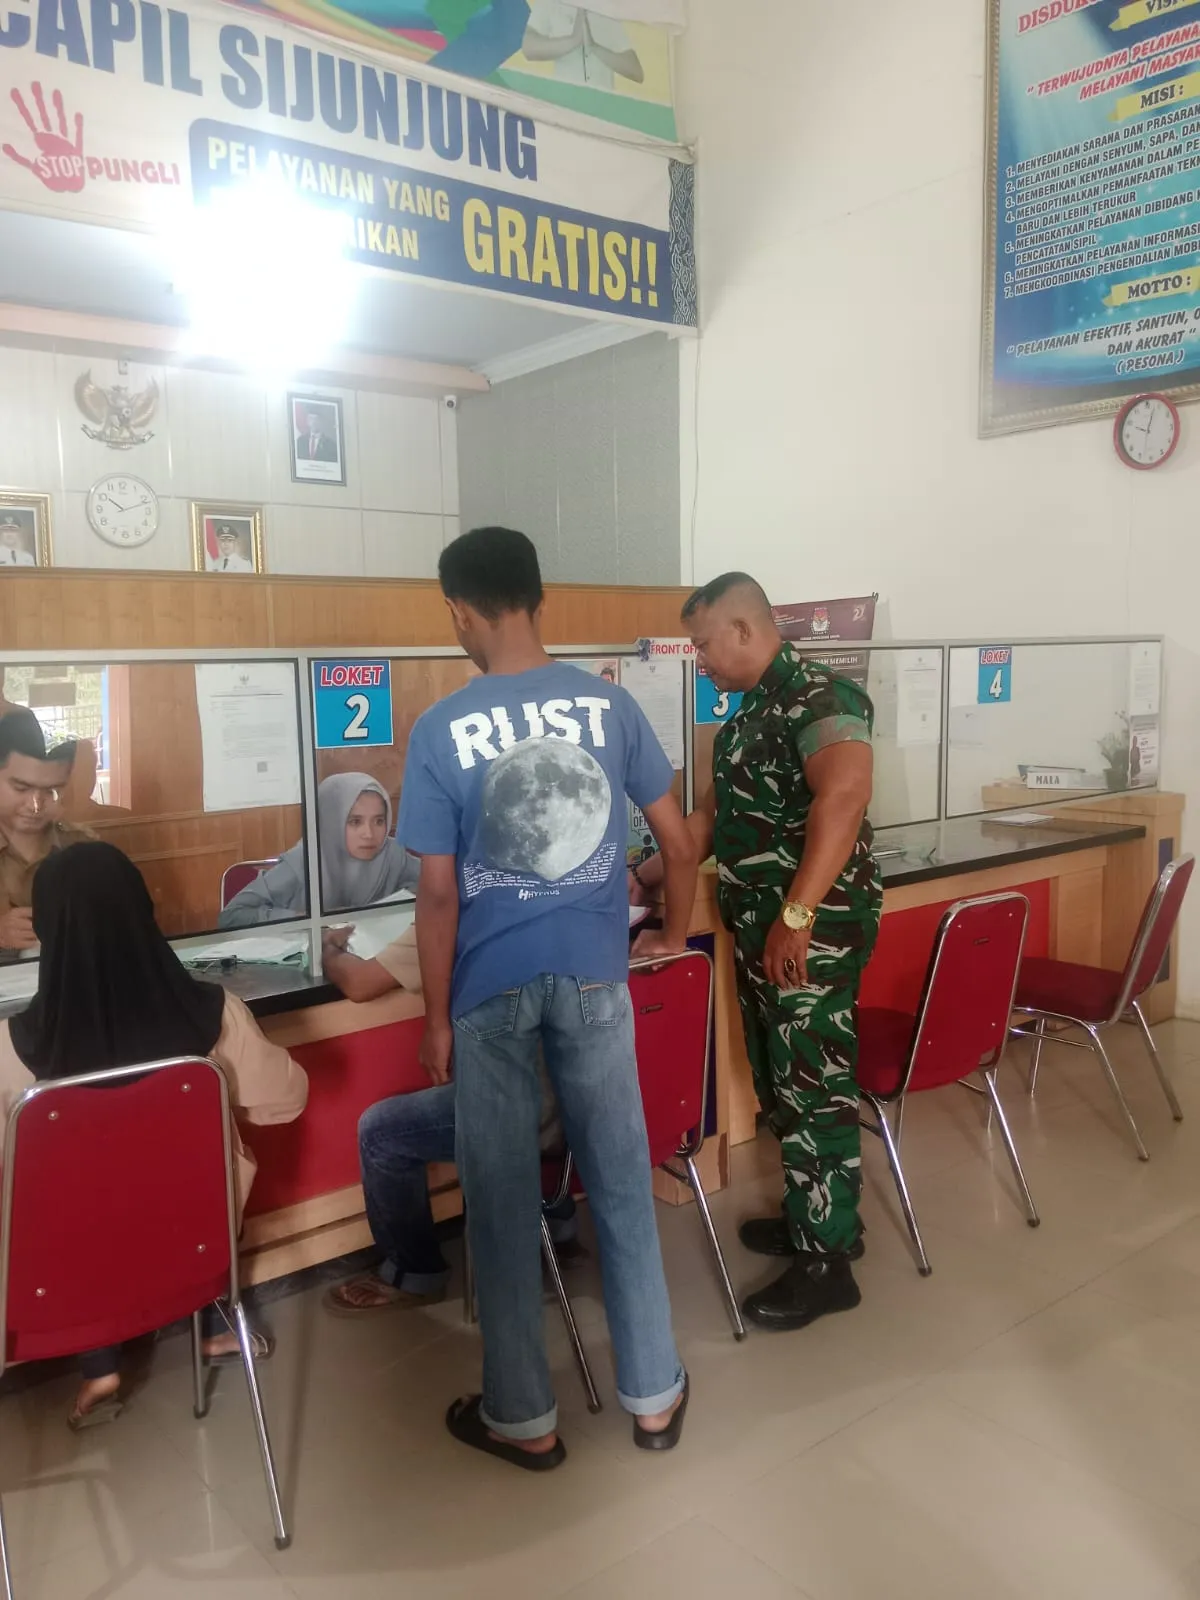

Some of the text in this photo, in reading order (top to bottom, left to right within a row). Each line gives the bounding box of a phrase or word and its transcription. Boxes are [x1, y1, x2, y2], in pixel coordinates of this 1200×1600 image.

[1018, 0, 1097, 33] DISDU
[1037, 51, 1129, 96] TERWUJUDNYA
[1131, 22, 1200, 61] PELAYANA
[218, 23, 538, 183] SIJUNJUNG
[1079, 63, 1146, 101] MELAYANI
[1140, 84, 1176, 109] MISI
[38, 154, 181, 186] STOP PUNGLI
[1017, 144, 1081, 174] MENYEDIAKAN
[1083, 133, 1121, 153] SARANA
[1123, 123, 1144, 139] DAN
[1017, 167, 1060, 190] MELAYANI
[1062, 154, 1100, 174] DENGAN
[1102, 139, 1146, 163] SENYUM,
[1149, 129, 1179, 147] SAPA,
[207, 136, 451, 223] PELAYANAN YANG
[1016, 186, 1100, 220] MENGOPTIMALKAN
[1102, 163, 1174, 193] PEMANFAATAN
[1017, 176, 1077, 205] MEMBERIKAN
[1079, 156, 1144, 186] KENYAMANAN
[1147, 143, 1183, 165] DALAM
[1016, 191, 1137, 235] BARU DAN LEBIH TERUKUR
[1016, 222, 1085, 250] MENINGKATKAN
[1087, 207, 1142, 231] PELAYANAN
[1144, 191, 1194, 215] DIBIDANG
[461, 196, 660, 308] GRATIS!!
[1015, 233, 1097, 266] PENCATATAN SIPIL
[1015, 252, 1084, 280] MENINGKATKAN
[1086, 237, 1141, 261] PELAYANAN
[1015, 266, 1095, 296] MENGKOORDINASI
[1097, 247, 1171, 275] PENGENDALIAN
[1127, 274, 1183, 300] MOTTO
[1016, 332, 1080, 357] PELAYANAN
[1083, 321, 1132, 343] EFEKTIF,
[1135, 310, 1189, 334] SANTUN,
[1107, 342, 1132, 356] DAN
[1135, 330, 1185, 352] AKURAT
[650, 643, 681, 655] FRONT
[980, 649, 1009, 665] LOKET
[320, 665, 385, 687] LOKET
[989, 668, 1003, 700] 4
[343, 693, 370, 740] 2
[449, 696, 611, 770] RUST
